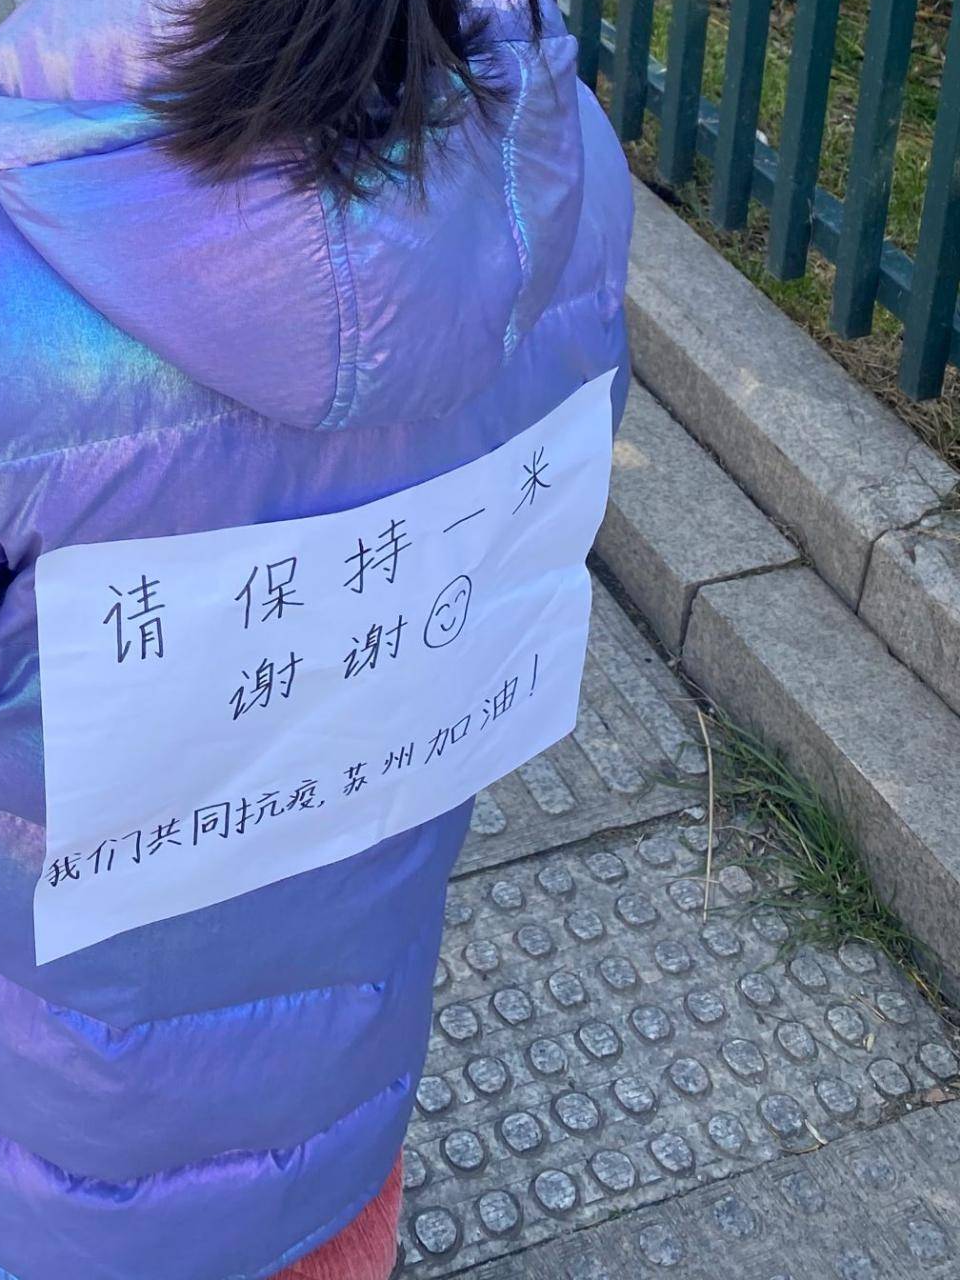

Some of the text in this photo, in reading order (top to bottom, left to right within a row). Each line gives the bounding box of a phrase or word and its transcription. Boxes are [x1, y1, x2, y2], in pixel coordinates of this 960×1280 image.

[102, 445, 553, 664] 请保持一米
[229, 614, 410, 721] 谢谢
